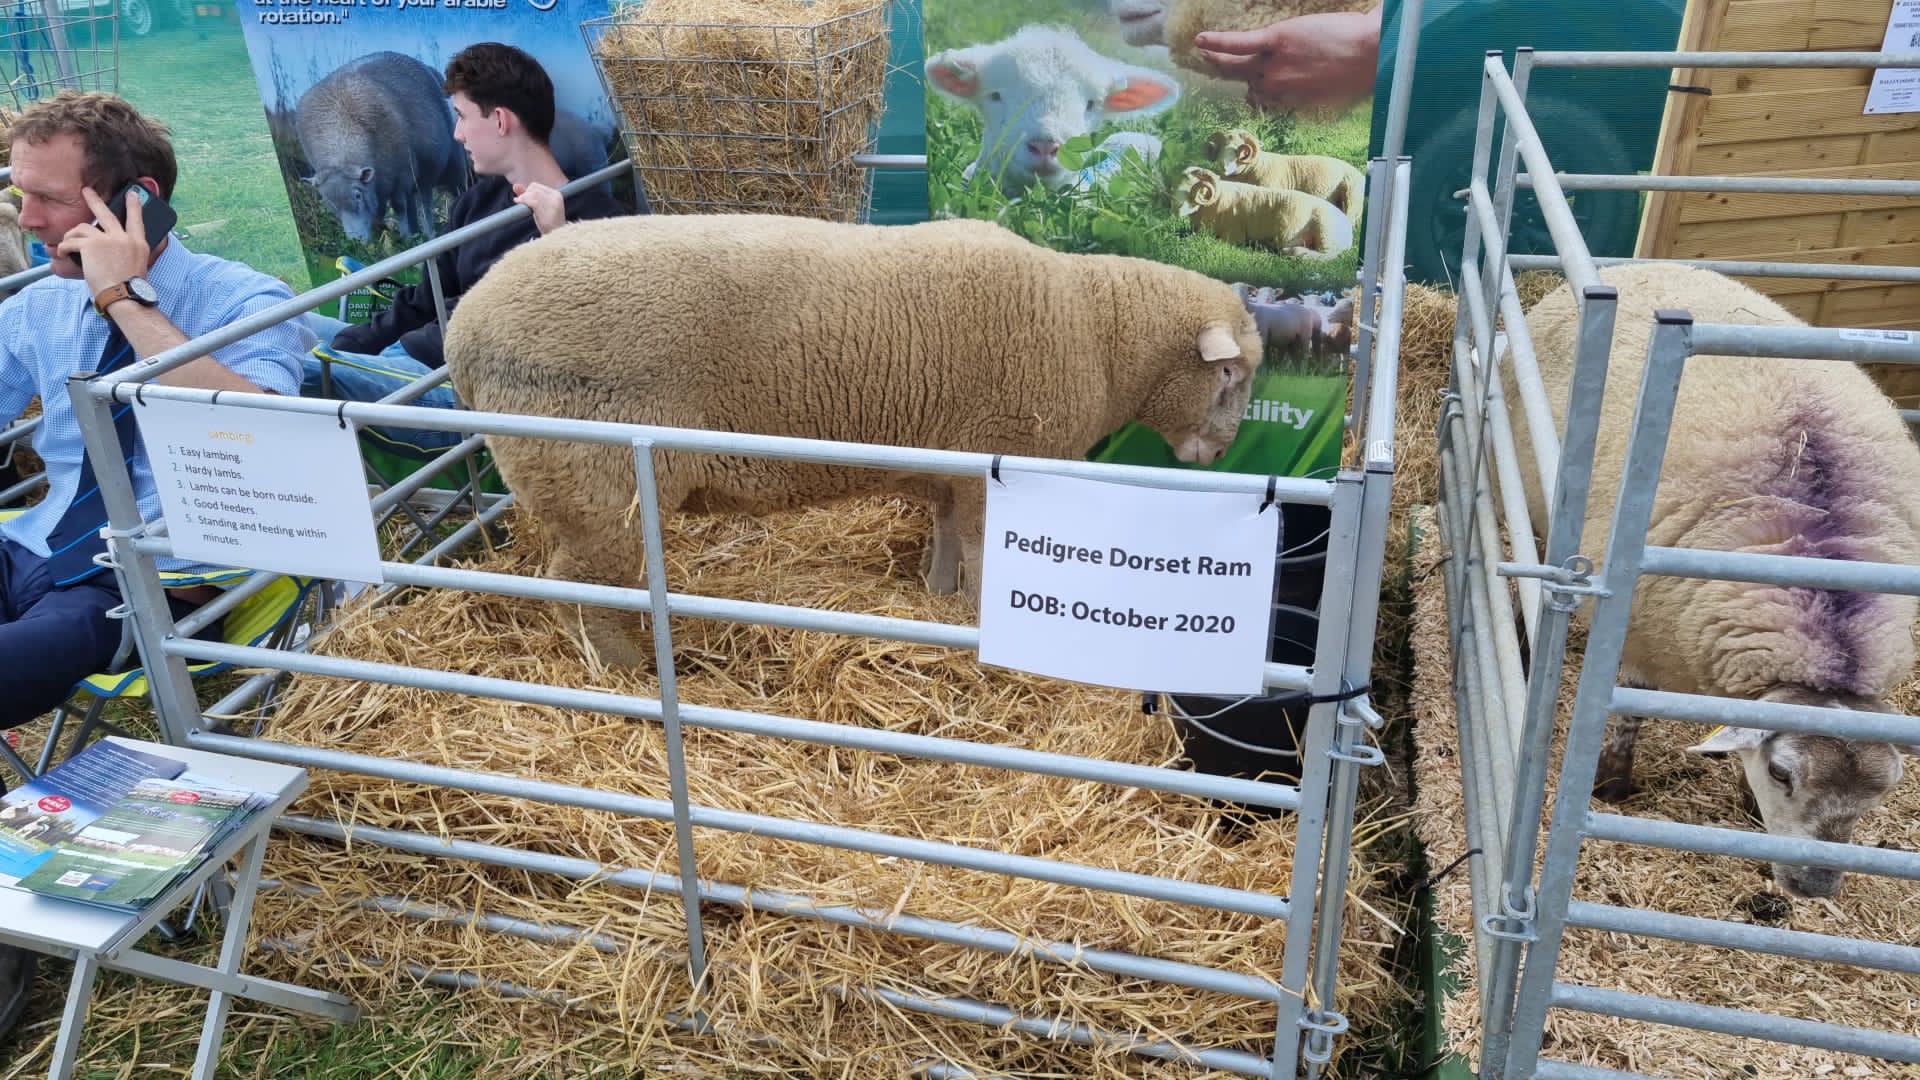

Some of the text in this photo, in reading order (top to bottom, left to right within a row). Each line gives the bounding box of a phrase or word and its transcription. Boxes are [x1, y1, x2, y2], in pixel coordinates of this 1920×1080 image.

[258, 8, 349, 24] rotation."
[180, 446, 201, 459] Easy
[202, 448, 243, 465] lambing.
[184, 464, 212, 478] Hardy
[214, 467, 245, 480] lambs.
[189, 481, 219, 494] Lambs
[220, 486, 237, 496] can
[238, 487, 251, 498] be
[252, 488, 275, 500] born
[277, 492, 318, 504] outside.
[193, 498, 218, 510] Good
[220, 501, 258, 515] feeders.
[198, 515, 238, 531] Standing
[239, 522, 256, 532] and
[258, 523, 294, 537] feeding
[296, 528, 327, 539] within
[203, 533, 242, 546] minutes.
[1004, 530, 1252, 577] Pedigree Dorset Ram
[1009, 589, 1236, 634] DOB: October 2020
